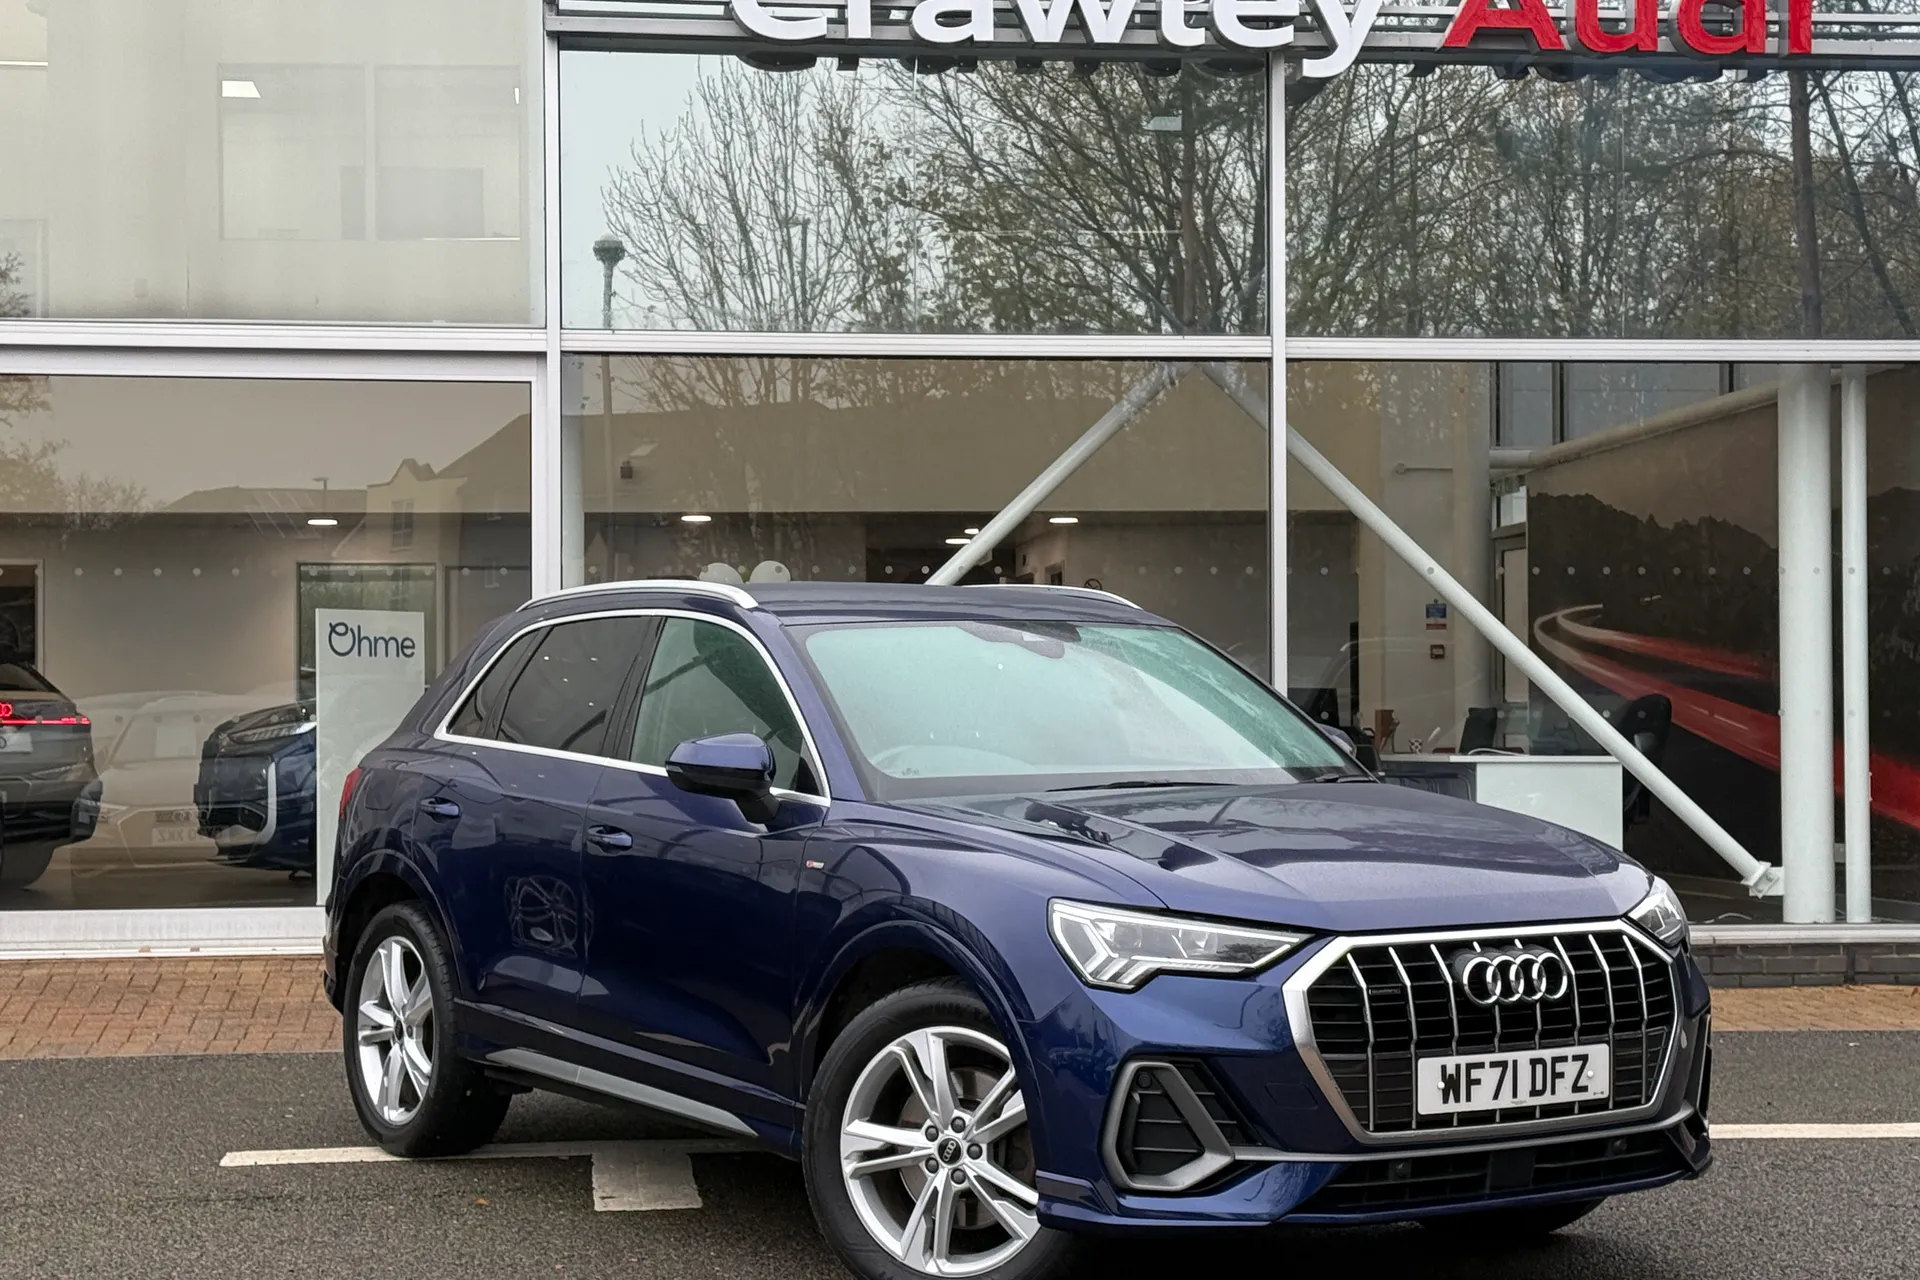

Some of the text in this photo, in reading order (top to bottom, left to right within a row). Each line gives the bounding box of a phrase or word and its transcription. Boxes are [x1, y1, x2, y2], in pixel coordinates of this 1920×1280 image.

[328, 622, 415, 658] Ohme
[1440, 1054, 1589, 1105] WF71 DFZ
